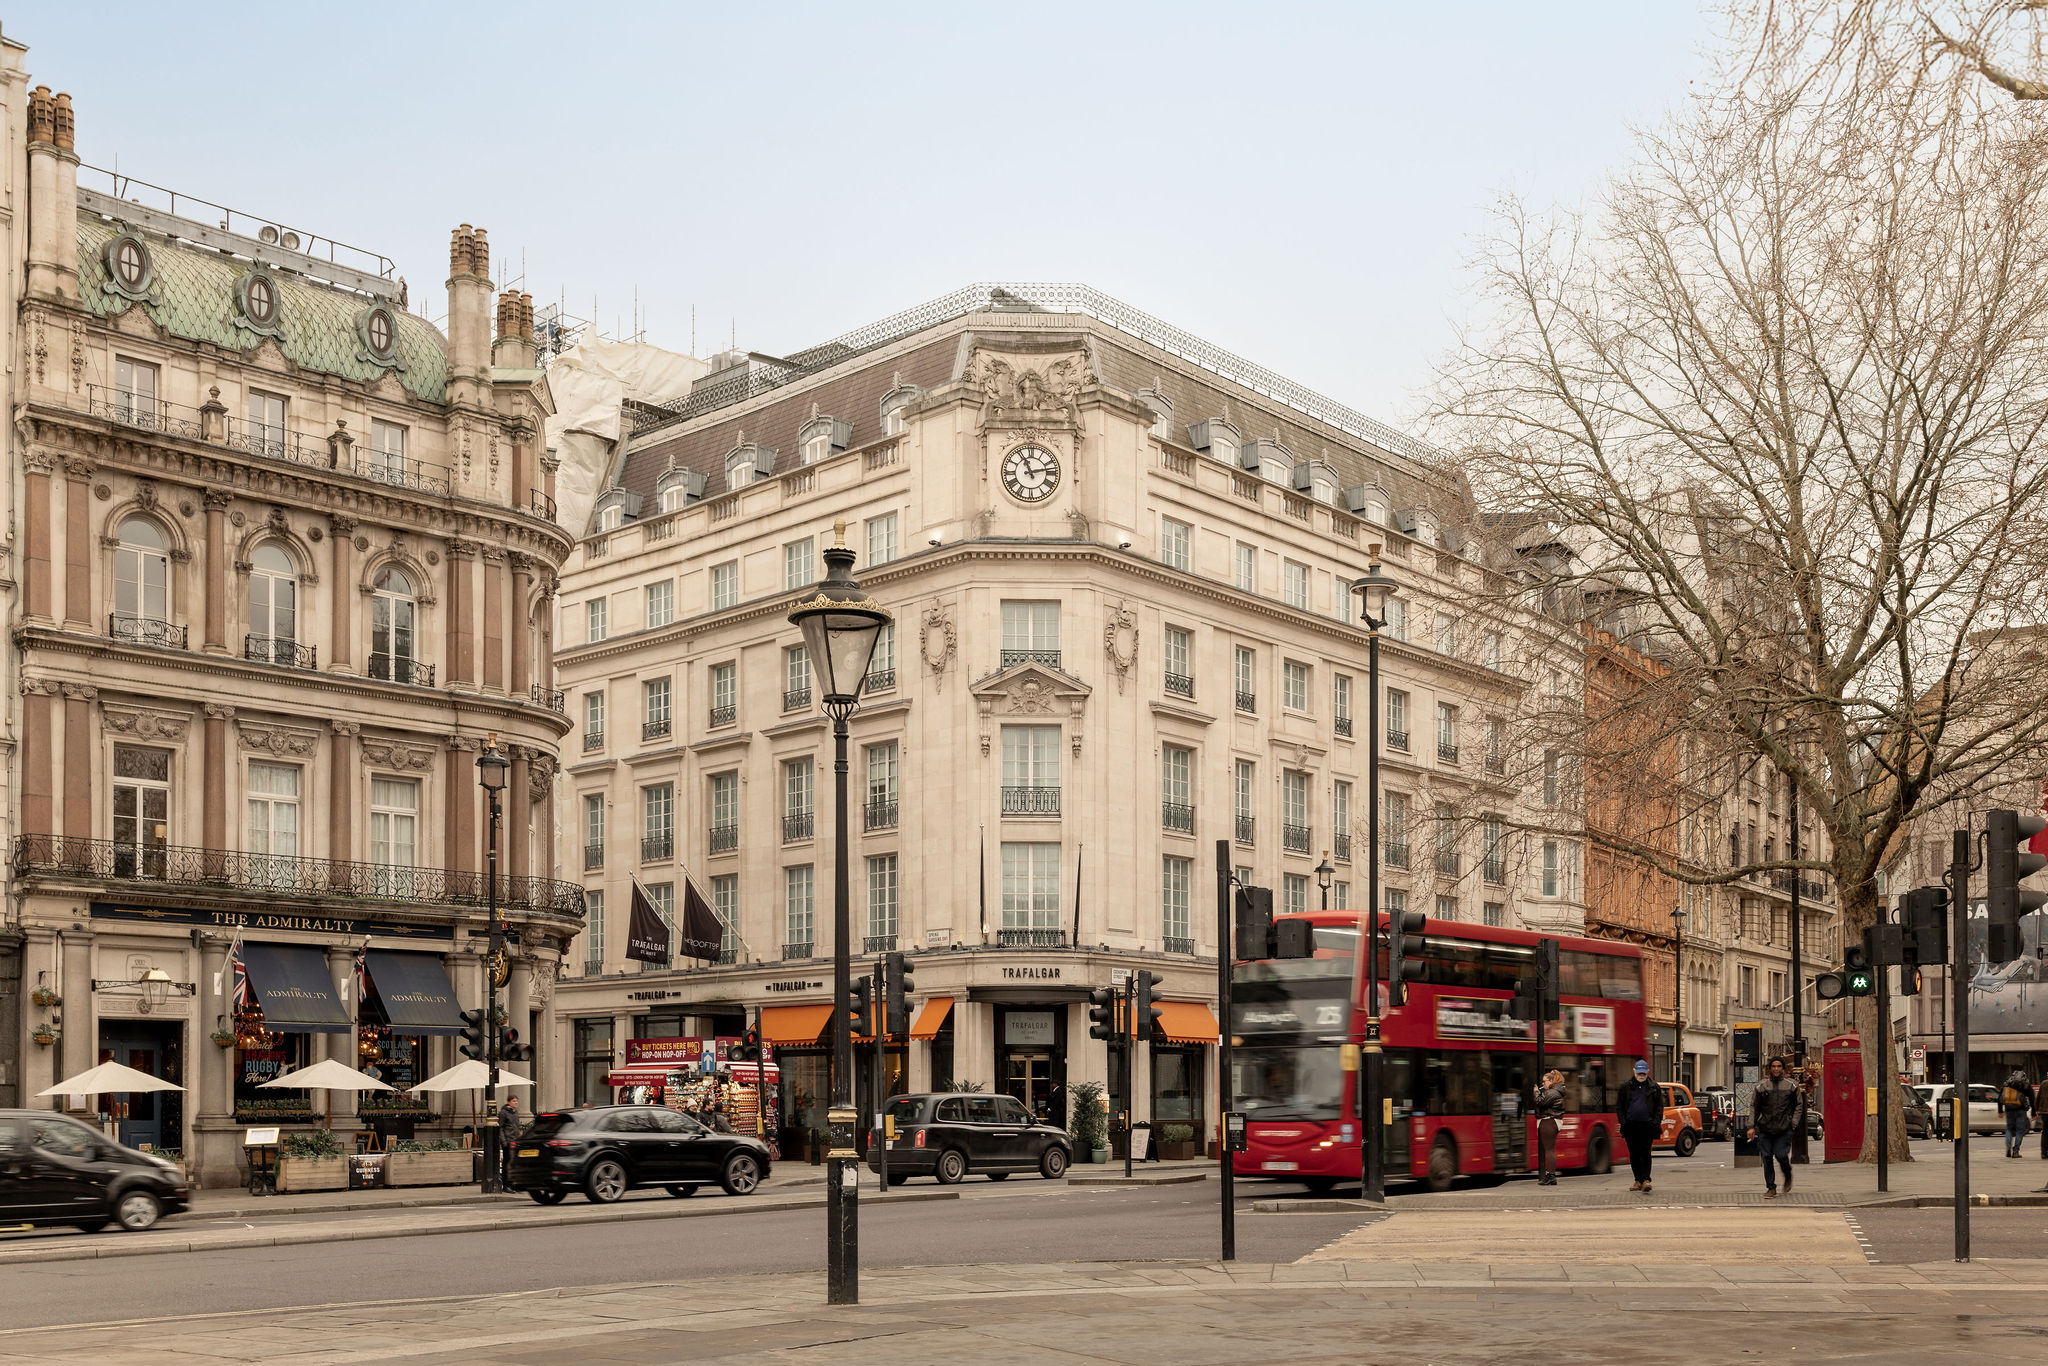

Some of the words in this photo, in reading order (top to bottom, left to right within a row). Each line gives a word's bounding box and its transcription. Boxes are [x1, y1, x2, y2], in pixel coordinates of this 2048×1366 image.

[212, 912, 248, 925] THE
[256, 915, 354, 932] ADMIRALTY
[631, 939, 665, 952] TRAFALGAR
[690, 939, 720, 950] ROOFTOP
[1002, 967, 1061, 979] TRAFALGAR
[772, 980, 806, 991] TRAFALGAR
[266, 989, 327, 1000] ADMIRALTY
[391, 994, 447, 1003] ADMIRALTY
[634, 990, 666, 1000] TRAFALGAR
[377, 1040, 411, 1049] SCOTLAND
[642, 1043, 651, 1051] BUY
[390, 1050, 411, 1058] HOUSE
[662, 1050, 687, 1058] HOP-OFF
[245, 1060, 279, 1072] RUGBY
[245, 1072, 272, 1083] Here!
